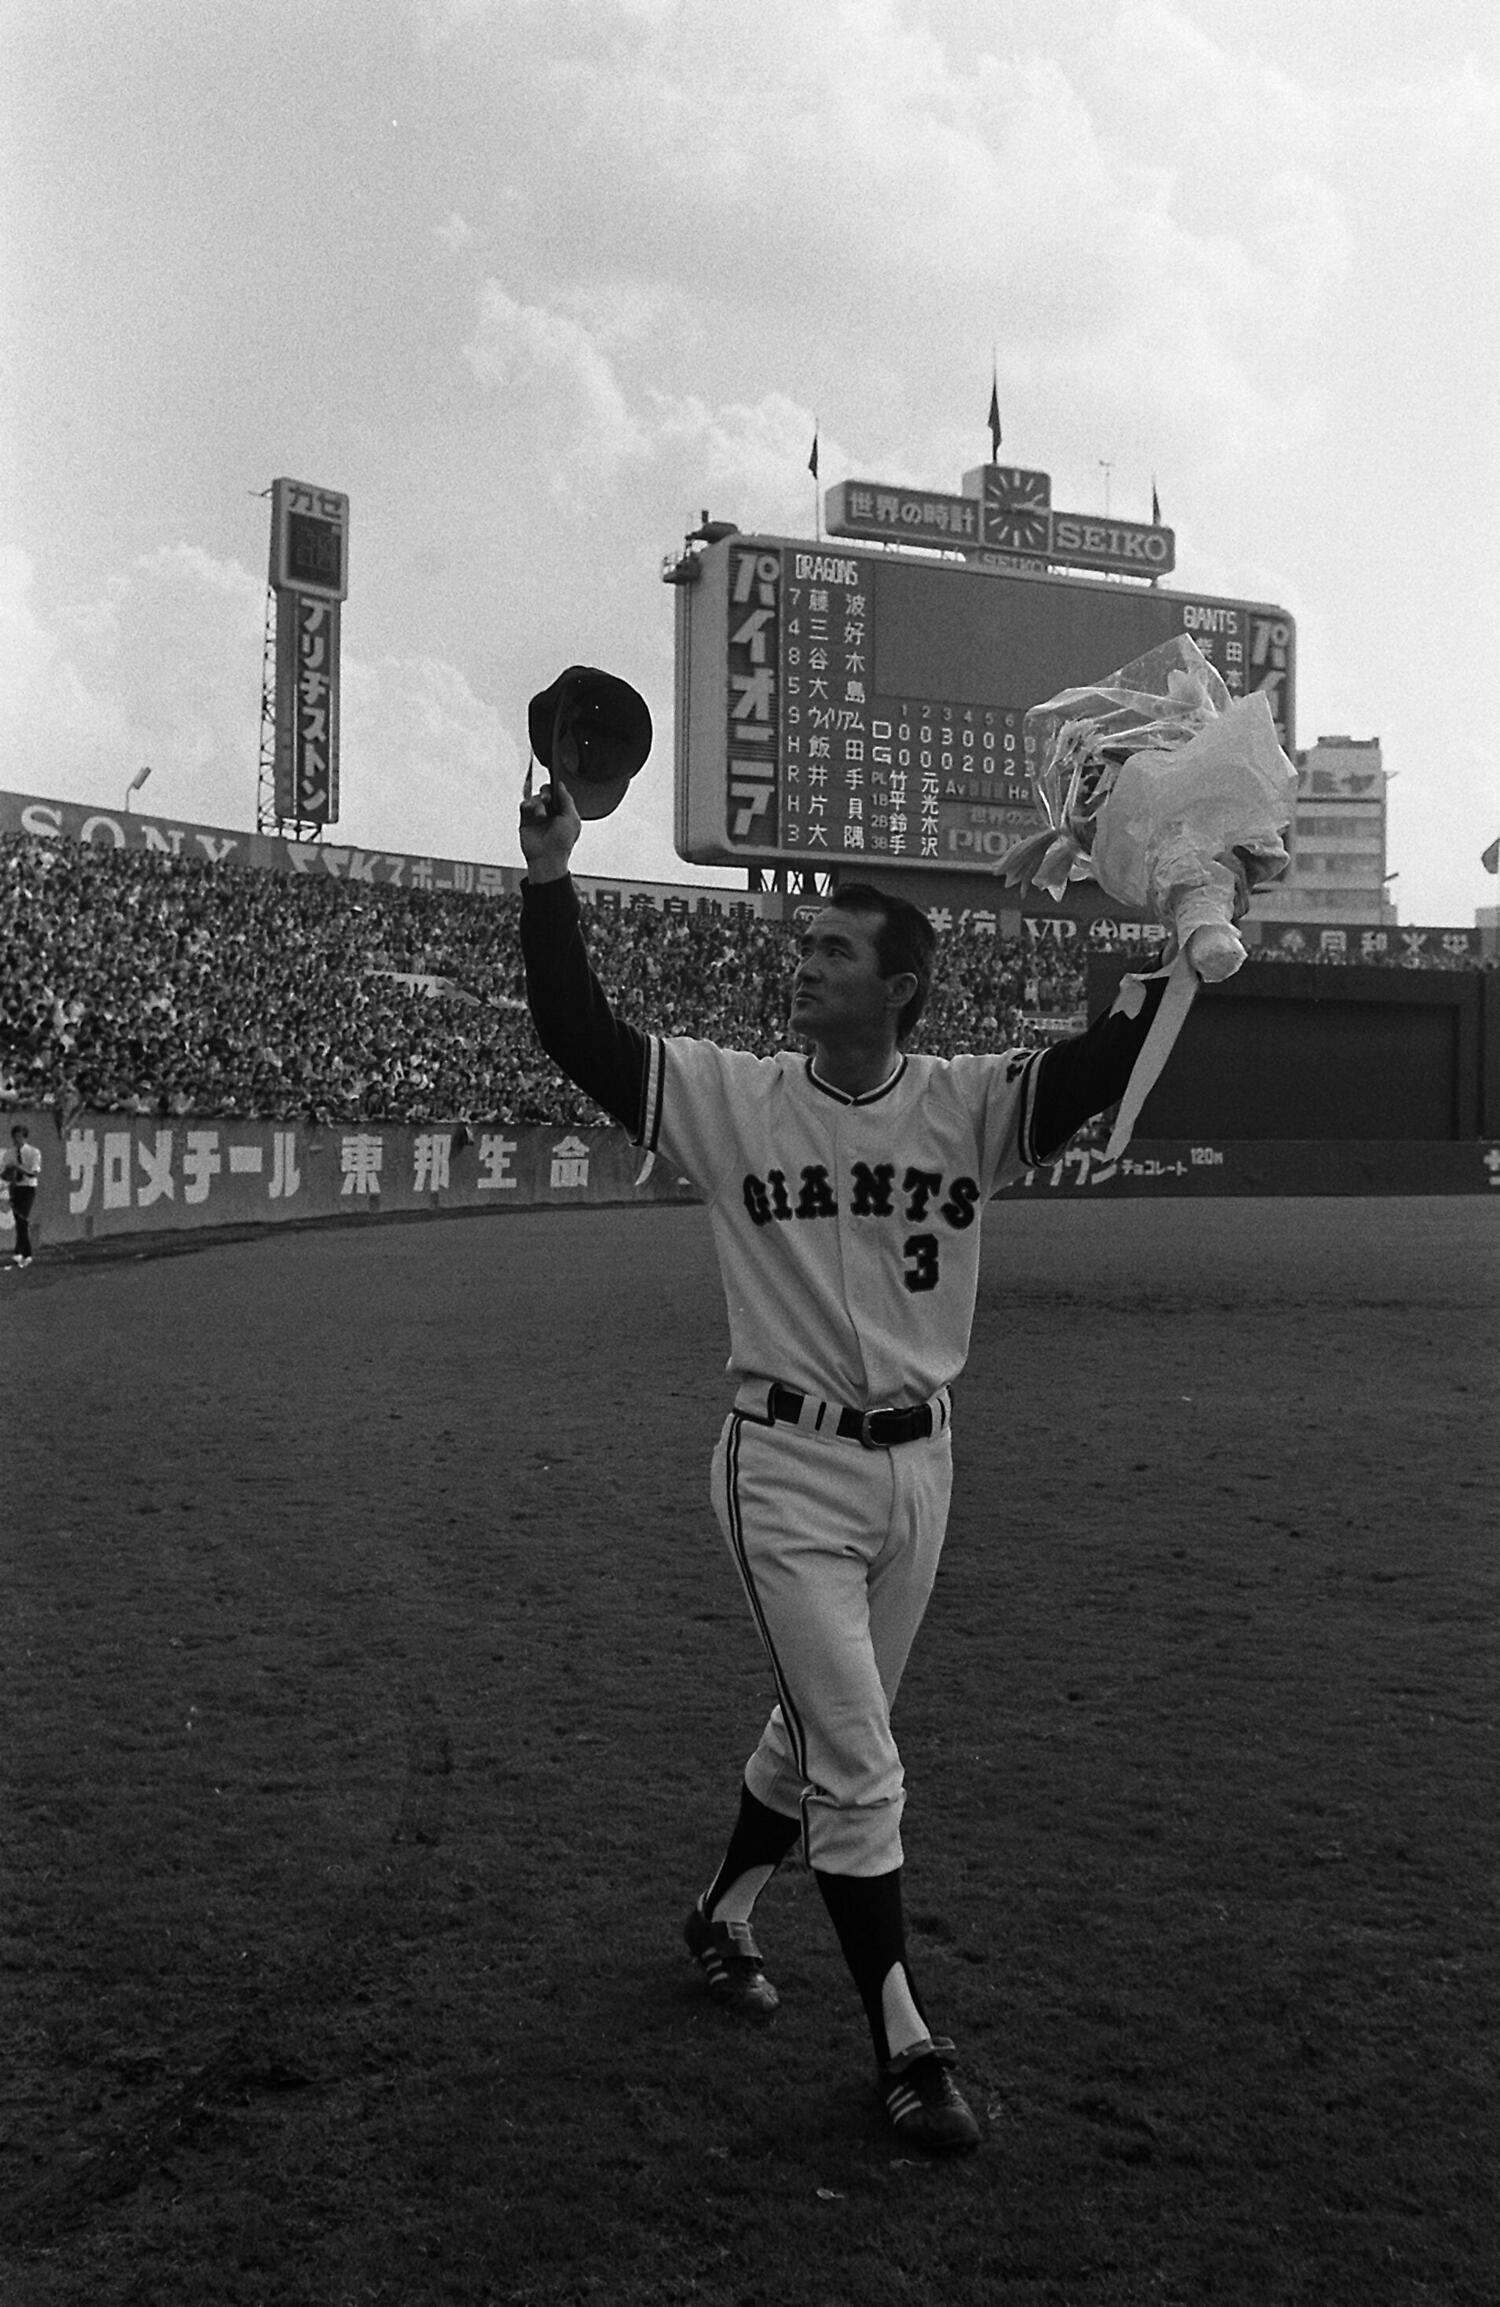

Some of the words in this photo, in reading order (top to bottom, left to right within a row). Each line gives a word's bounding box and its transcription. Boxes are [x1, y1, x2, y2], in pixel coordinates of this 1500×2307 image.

[850, 492, 975, 535] 世界の時計
[1056, 522, 1168, 562] SEIKO
[795, 554, 858, 585] DRAGONS
[788, 588, 801, 605] 7
[809, 589, 866, 617] 藤波
[788, 618, 801, 634] 4
[809, 619, 866, 645] 三好
[1184, 605, 1238, 635] GIANTS
[788, 647, 801, 664] 8
[808, 647, 865, 673] 谷木
[299, 597, 331, 812] ブリヂストン
[731, 553, 780, 836] パイオニア
[788, 677, 801, 694] 5
[808, 678, 865, 704] 大島
[902, 704, 908, 717] 1
[921, 705, 932, 719] 2
[943, 706, 953, 721] 3
[963, 709, 973, 724] 4
[985, 711, 995, 726] 5
[1005, 713, 1015, 728] 6
[788, 735, 800, 753] H
[808, 735, 865, 761] 飯田
[899, 723, 910, 741] 0
[920, 726, 932, 743] 0
[941, 727, 953, 745] 3
[962, 730, 974, 747] 0
[983, 732, 995, 749] 0
[1004, 734, 1016, 752] 0
[872, 746, 892, 765] G
[899, 748, 910, 766] 0
[920, 750, 932, 768] 0
[941, 752, 953, 770] 0
[962, 755, 974, 773] 2
[983, 757, 995, 774] 0
[1004, 758, 1016, 777] 2
[788, 765, 800, 783] R
[808, 765, 864, 790] 井手
[871, 771, 888, 785] PL
[889, 769, 940, 794] 竹元
[788, 794, 800, 812] H
[808, 795, 863, 820] 片貝
[872, 793, 888, 806] 1B
[889, 791, 939, 816] 平光
[21, 804, 239, 864] SONY
[787, 824, 800, 842] 3
[808, 823, 864, 849] 大隅
[871, 814, 888, 828] 2B
[889, 813, 939, 835] 鈴木
[871, 836, 888, 851] 3B
[889, 834, 939, 858] 手沢
[66, 1128, 301, 1214] サロメチール
[340, 1133, 590, 1194] 東邦生命
[1121, 1159, 1189, 1178] チョコレート
[742, 1161, 980, 1230] GIANTS
[902, 1232, 940, 1293] 3
